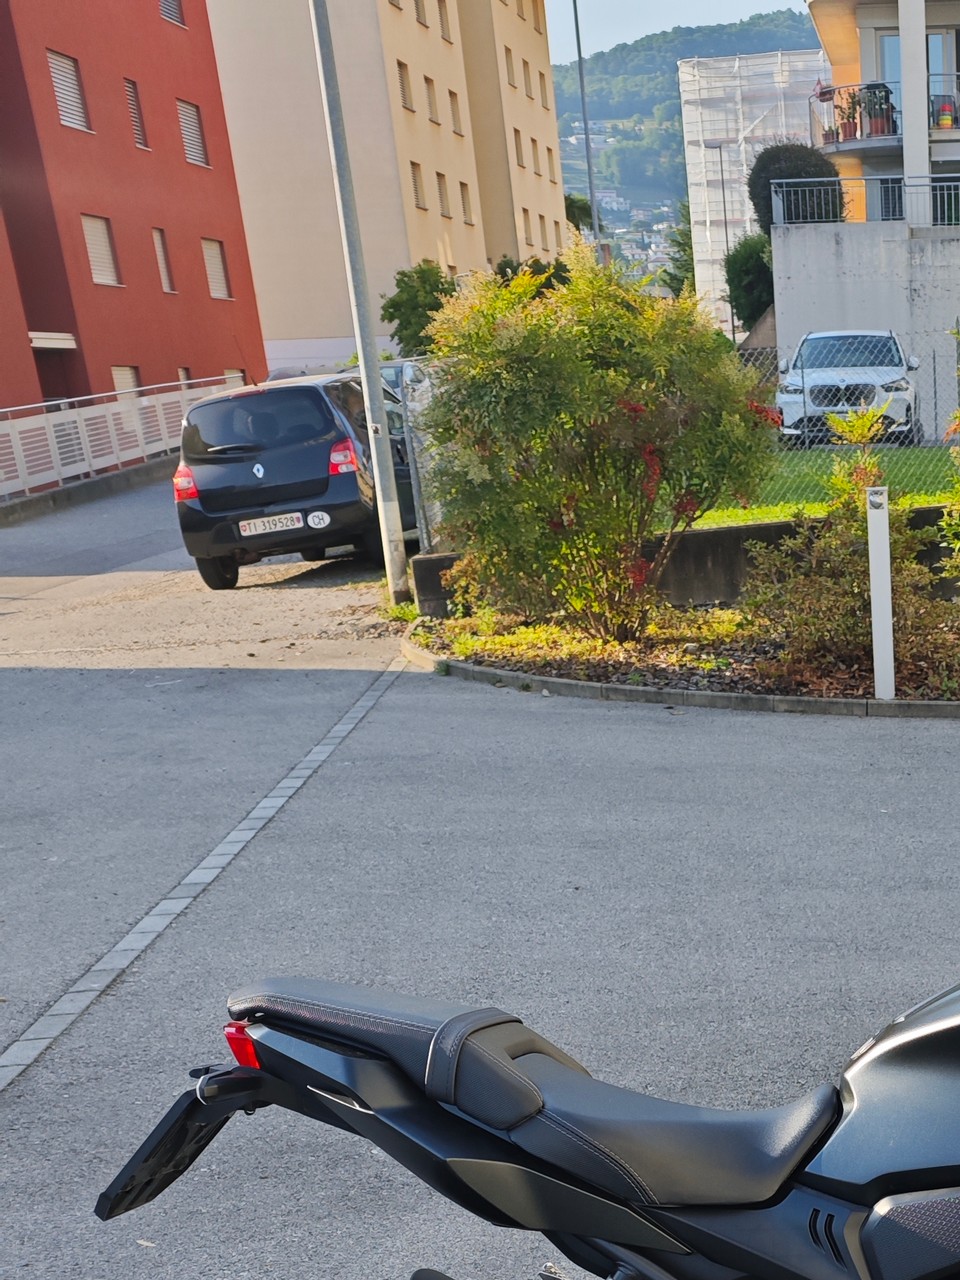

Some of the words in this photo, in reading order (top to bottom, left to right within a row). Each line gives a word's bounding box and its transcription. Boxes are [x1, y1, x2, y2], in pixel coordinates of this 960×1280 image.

[246, 522, 257, 533] TI
[261, 516, 296, 531] 319528
[311, 513, 326, 527] CH
